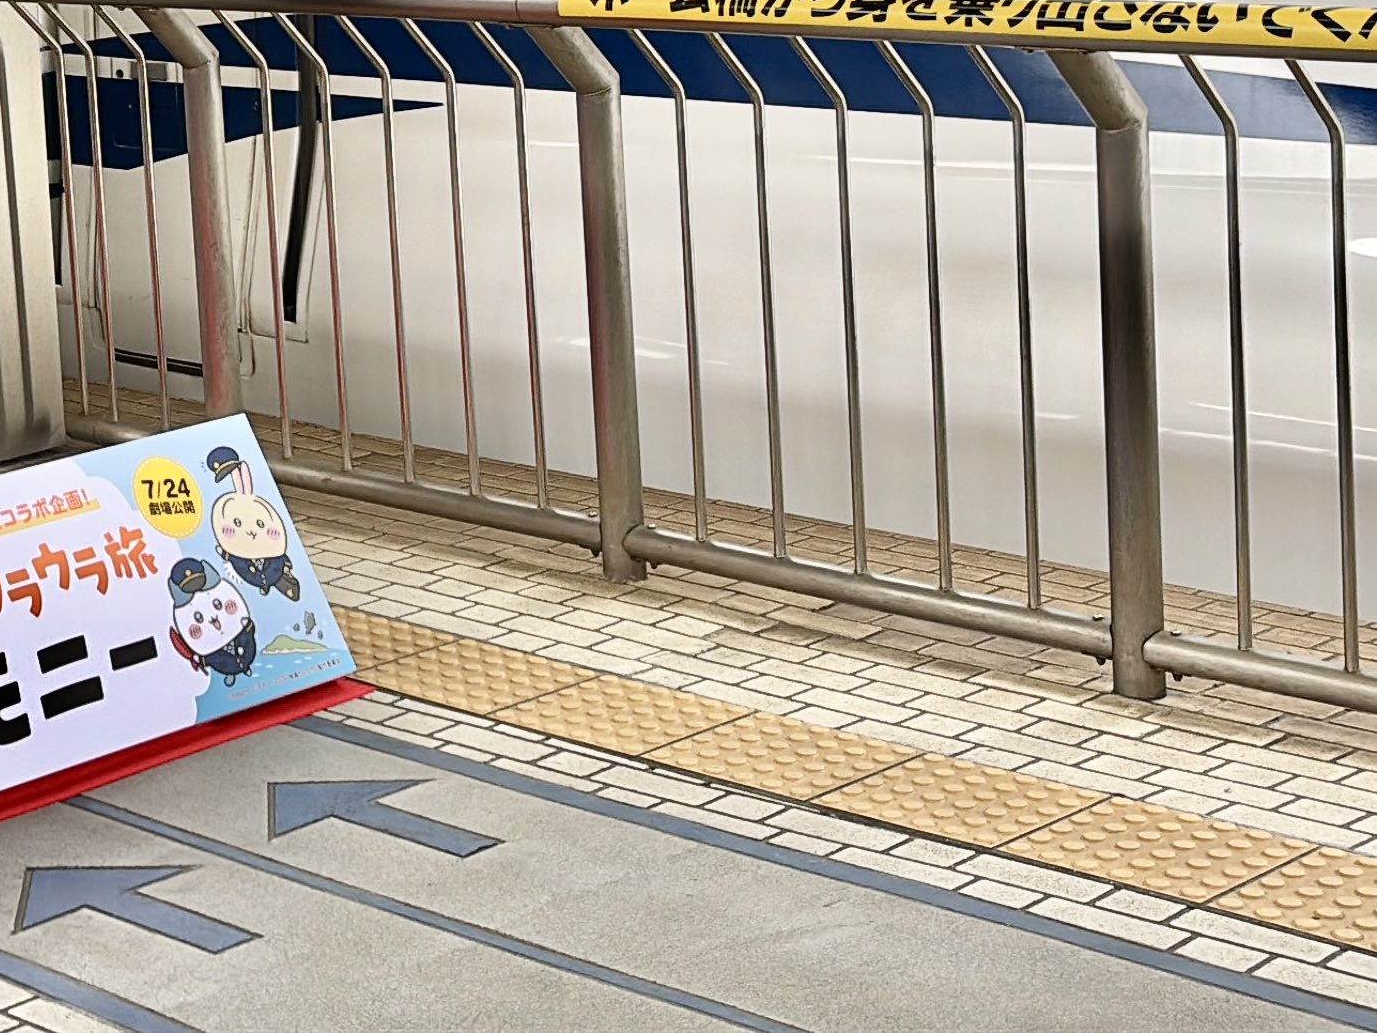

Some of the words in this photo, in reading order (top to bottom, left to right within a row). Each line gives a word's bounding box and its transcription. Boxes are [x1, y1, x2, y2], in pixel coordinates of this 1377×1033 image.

[141, 478, 191, 499] 7/24
[148, 500, 196, 517] 劇場公開
